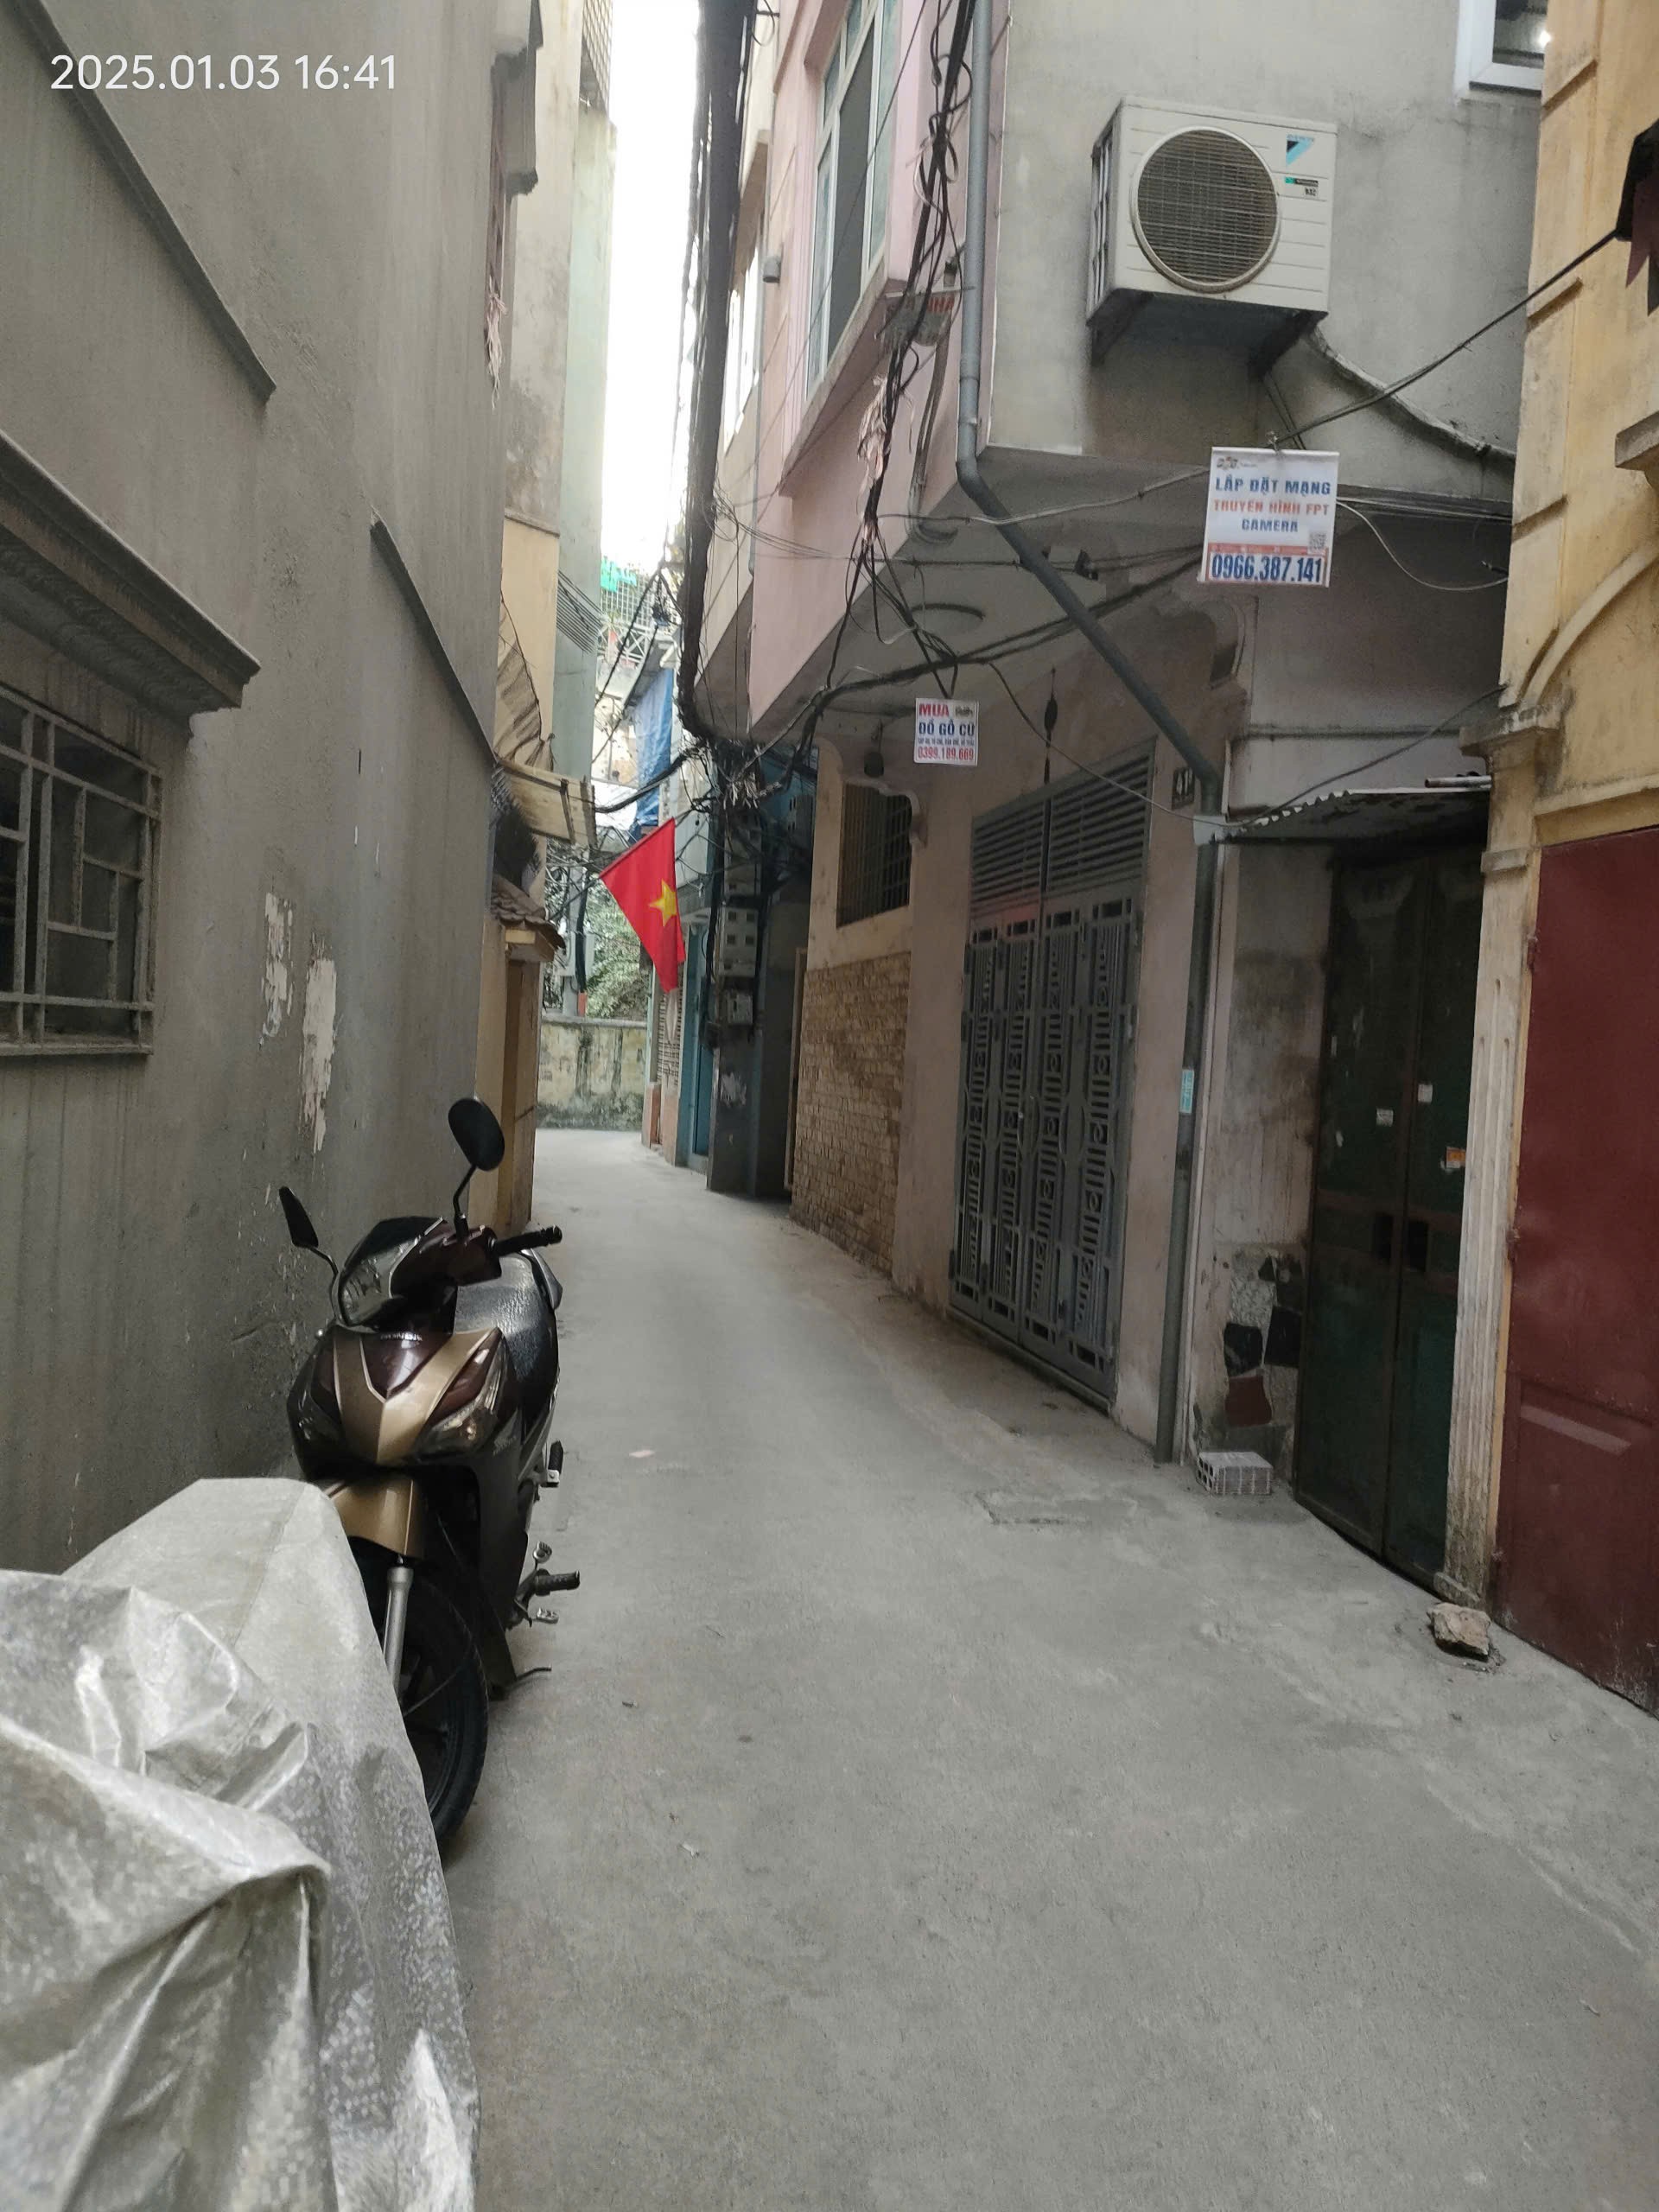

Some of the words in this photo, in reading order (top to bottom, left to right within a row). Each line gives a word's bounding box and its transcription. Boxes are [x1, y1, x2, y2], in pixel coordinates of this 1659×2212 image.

[1285, 480, 1332, 498] MẠNG
[1269, 499, 1300, 515] HÌNH
[1306, 504, 1331, 516] FPT
[1242, 518, 1299, 533] CAMERA
[1211, 554, 1322, 583] 0966.387.141
[918, 703, 950, 717] MUA
[918, 718, 935, 735] ĐỒ
[938, 717, 955, 736] GỖ
